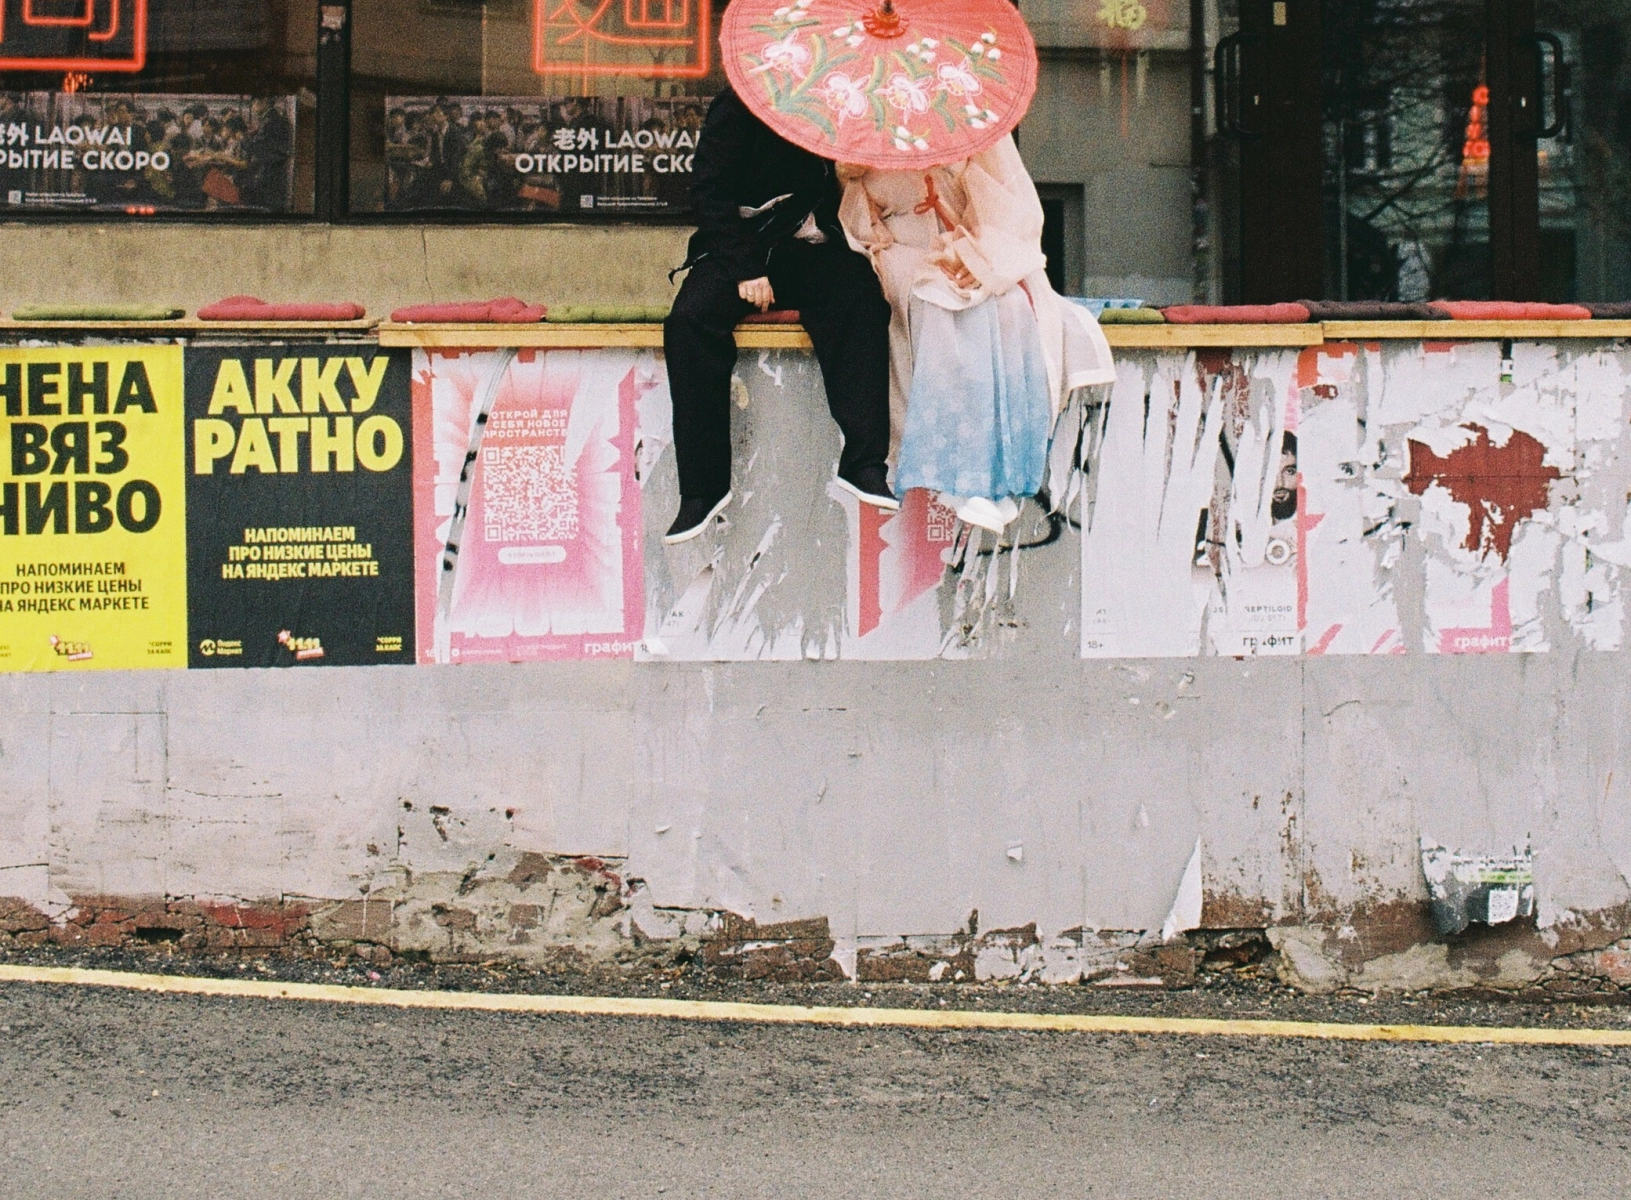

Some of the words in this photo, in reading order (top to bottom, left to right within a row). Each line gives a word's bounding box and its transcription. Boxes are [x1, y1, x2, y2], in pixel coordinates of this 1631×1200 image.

[34, 124, 132, 146] LAOWAI
[552, 127, 600, 151] 老外
[82, 150, 171, 172] СКОРО
[515, 153, 645, 174] ОТКРЫТИЕ
[207, 356, 390, 416] АККУ
[490, 408, 539, 420] ОТКРОЙ
[541, 409, 568, 420] ДЛЯ
[492, 420, 524, 430] СЕБЯ
[527, 418, 566, 429] НОВОЕ
[10, 420, 130, 477] ВЯЗ
[193, 414, 404, 475] РАТНО
[245, 526, 356, 544] НАПОМИНАЕМ
[228, 545, 262, 562] ПРО
[263, 544, 325, 561] НИЗКИЕ
[325, 543, 372, 561] ЦЕНЫ
[16, 562, 126, 577] НАПОМИНАЕМ
[221, 563, 245, 580] НА
[246, 562, 307, 581] ЯНДЕКС
[307, 560, 380, 577] МАРКЕТЕ
[0, 580, 31, 595] ПРО
[34, 580, 95, 595] НИЗКИЕ
[97, 578, 142, 596] ЦЕНЫ
[0, 599, 14, 613] А
[17, 598, 76, 614] ЯНДЕКС
[79, 596, 150, 611] МАРКЕТЕ
[584, 639, 634, 656] графи
